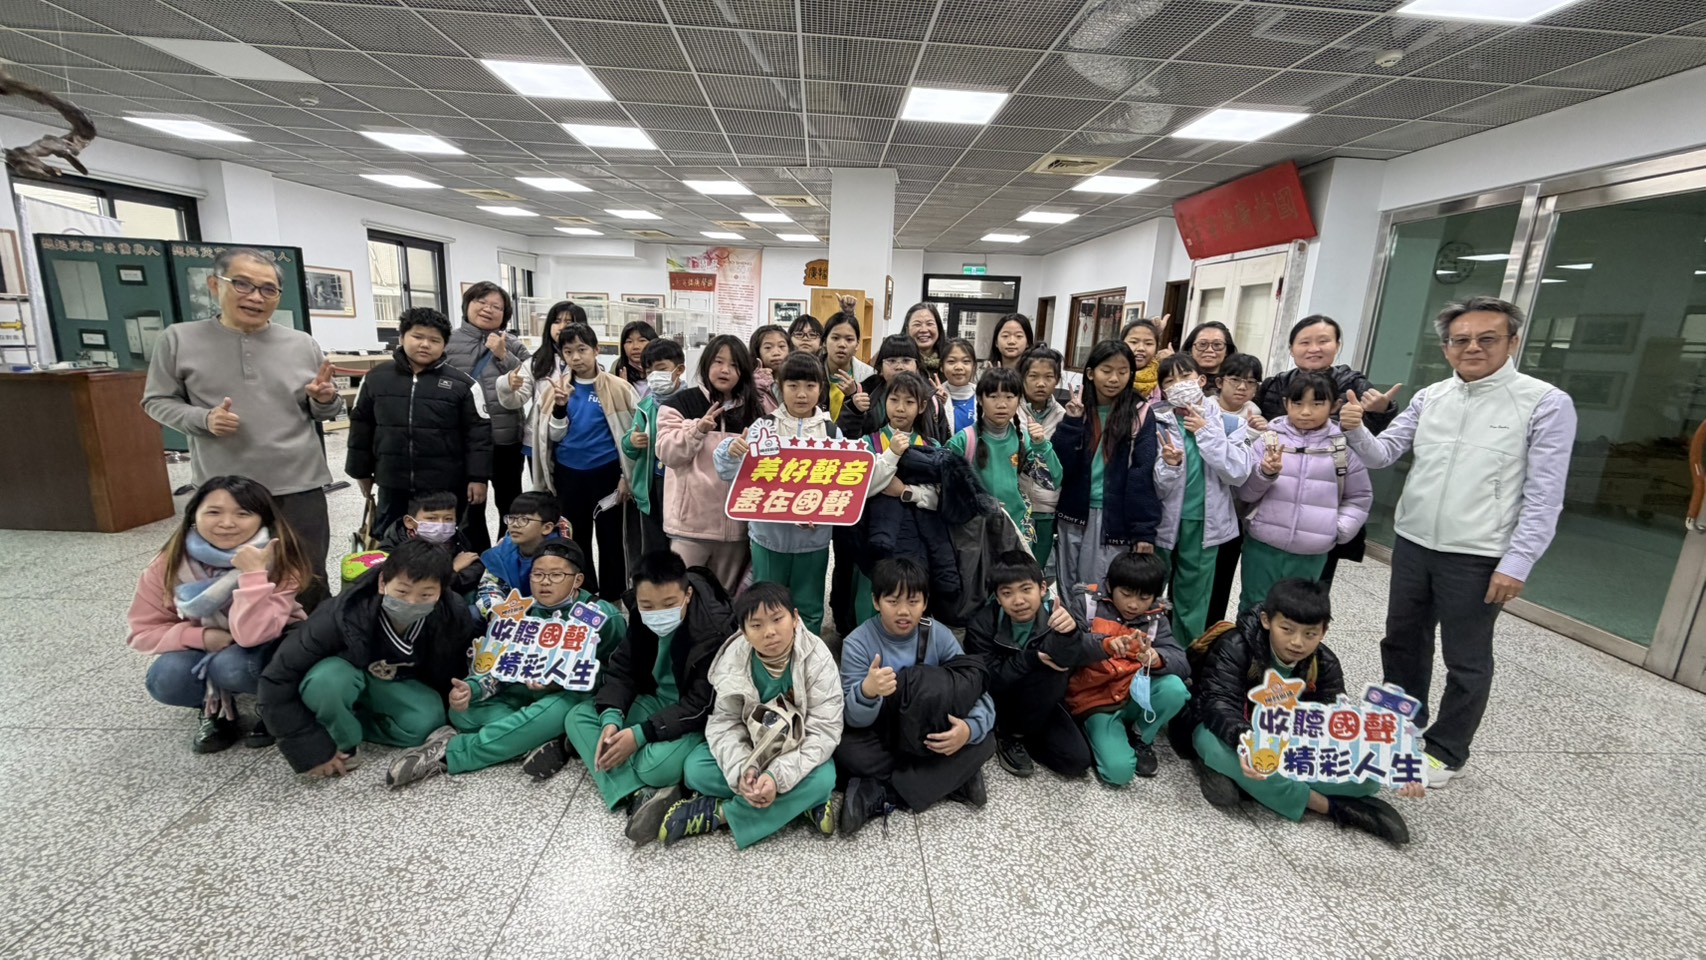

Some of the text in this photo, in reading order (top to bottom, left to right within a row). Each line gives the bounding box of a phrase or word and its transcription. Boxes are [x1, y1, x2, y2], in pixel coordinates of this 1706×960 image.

[751, 457, 869, 485] 美好聲音
[730, 487, 853, 516] 盡在國聲
[490, 619, 588, 652] 收聽國聲
[495, 652, 595, 685] 精彩人生
[1259, 708, 1397, 744] 收聽國聲
[1283, 746, 1423, 783] 精彩人生
